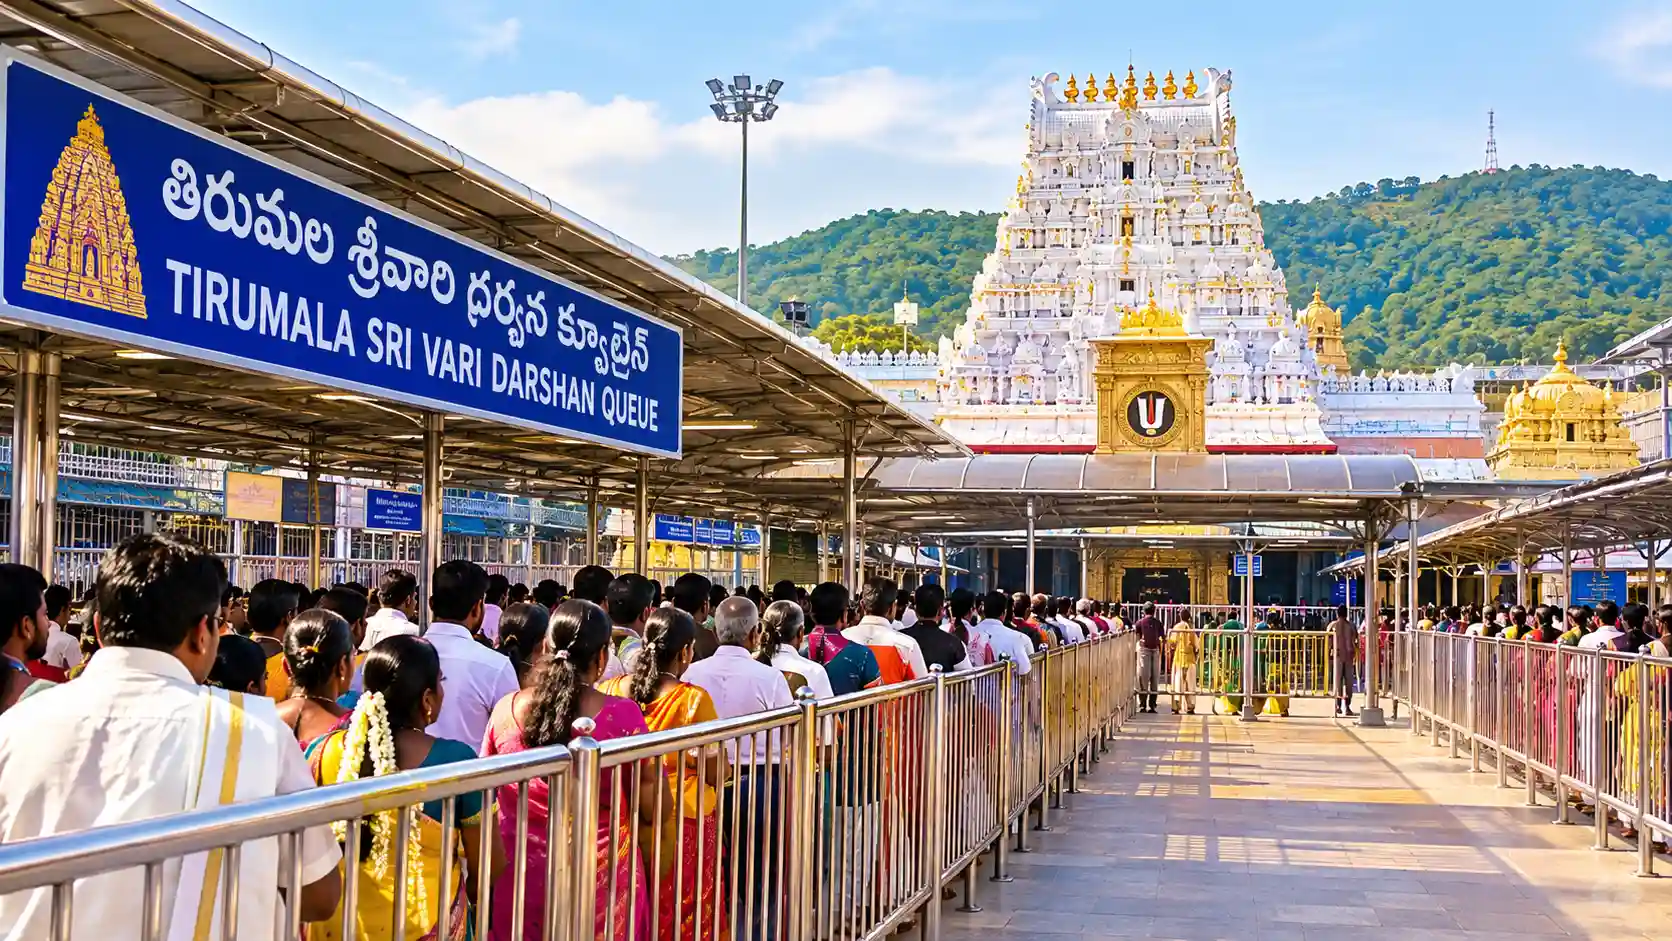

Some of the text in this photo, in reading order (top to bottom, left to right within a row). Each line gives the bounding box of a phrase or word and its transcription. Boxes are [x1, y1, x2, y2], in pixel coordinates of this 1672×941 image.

[163, 159, 334, 264] తిరుమల
[348, 216, 455, 304] శ్రీవారి
[166, 259, 658, 431] TIRUMALA SRI VARI DARSHAN QUEUE
